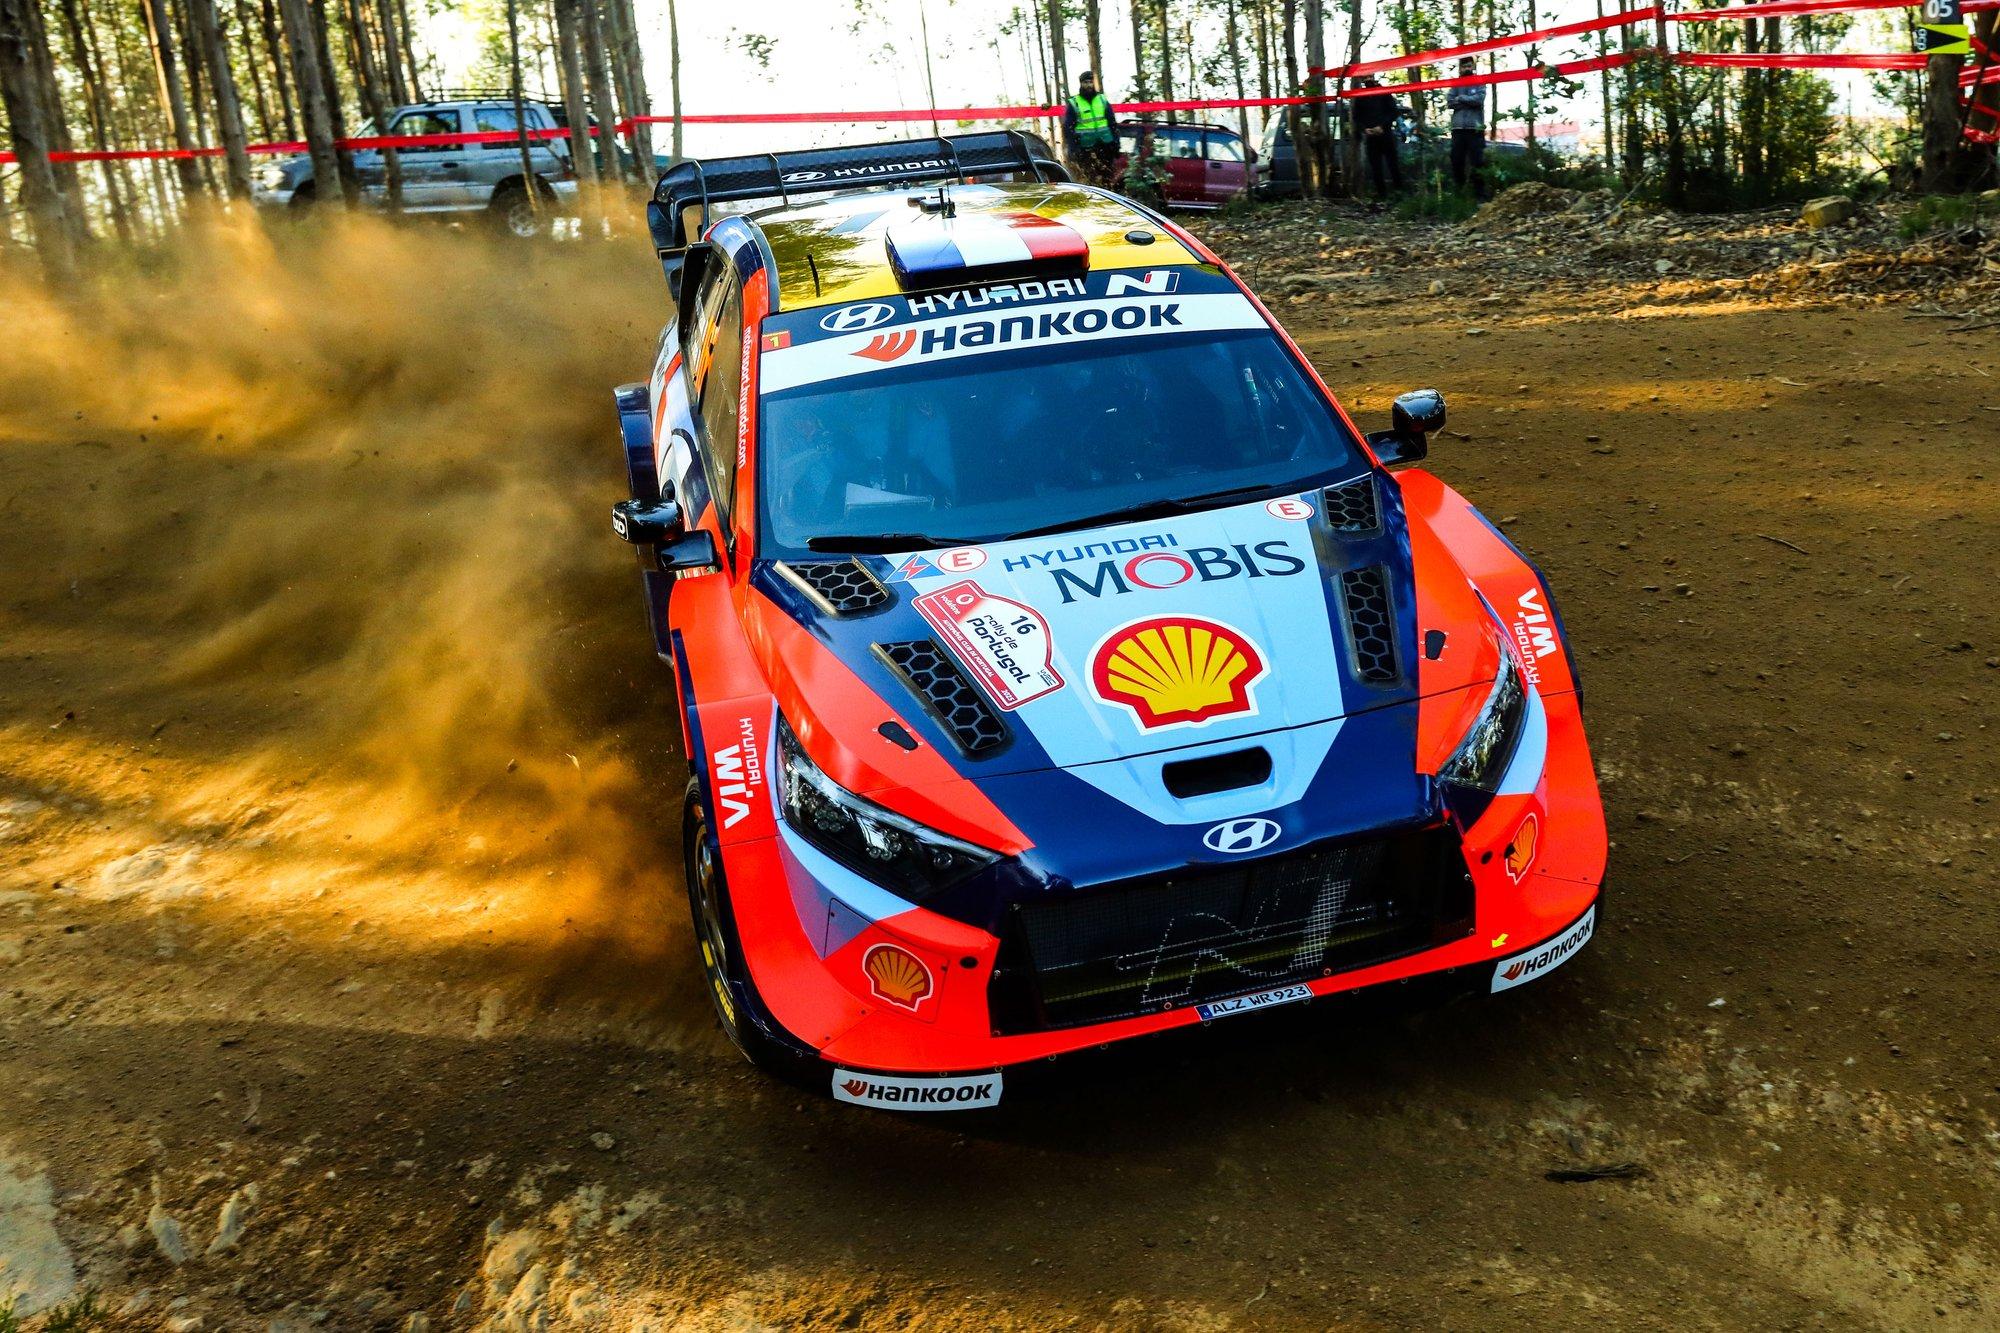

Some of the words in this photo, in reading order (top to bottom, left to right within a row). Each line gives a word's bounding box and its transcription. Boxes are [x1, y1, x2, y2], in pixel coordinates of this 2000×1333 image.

[833, 159, 948, 177] HYUNDAI
[908, 277, 1087, 315] HYUNDAI
[769, 336, 780, 348] 1
[1277, 503, 1301, 515] E
[952, 552, 972, 567] E
[1003, 533, 1179, 572] HYUNDAI
[1047, 540, 1306, 604] MOBIS
[984, 614, 1007, 637] rally
[1003, 636, 1018, 649] de
[1010, 615, 1037, 635] 16
[966, 617, 1031, 684] Portugal
[1513, 622, 1541, 684] HYUNDAI
[739, 717, 762, 785] HYUNDAI
[1212, 1000, 1246, 1014] ALZ
[1249, 994, 1274, 1006] WR
[1274, 985, 1307, 1000] 923
